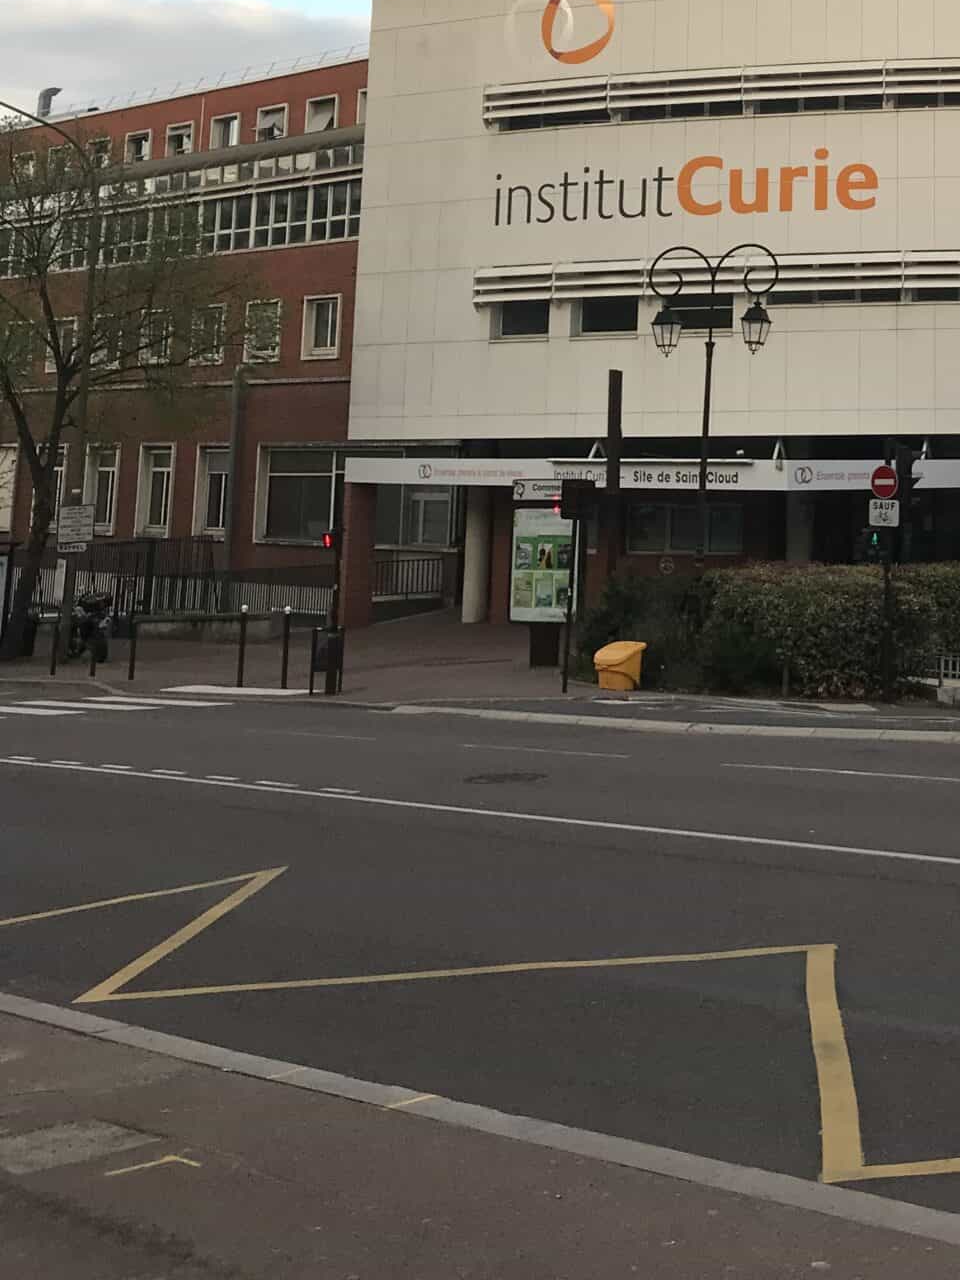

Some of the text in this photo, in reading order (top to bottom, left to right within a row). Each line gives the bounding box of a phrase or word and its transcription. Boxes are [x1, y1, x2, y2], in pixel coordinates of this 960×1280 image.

[585, 470, 607, 483] Curi
[633, 470, 653, 483] Site
[657, 471, 671, 483] de
[675, 471, 700, 484] Sain
[872, 501, 896, 511] SAUF
